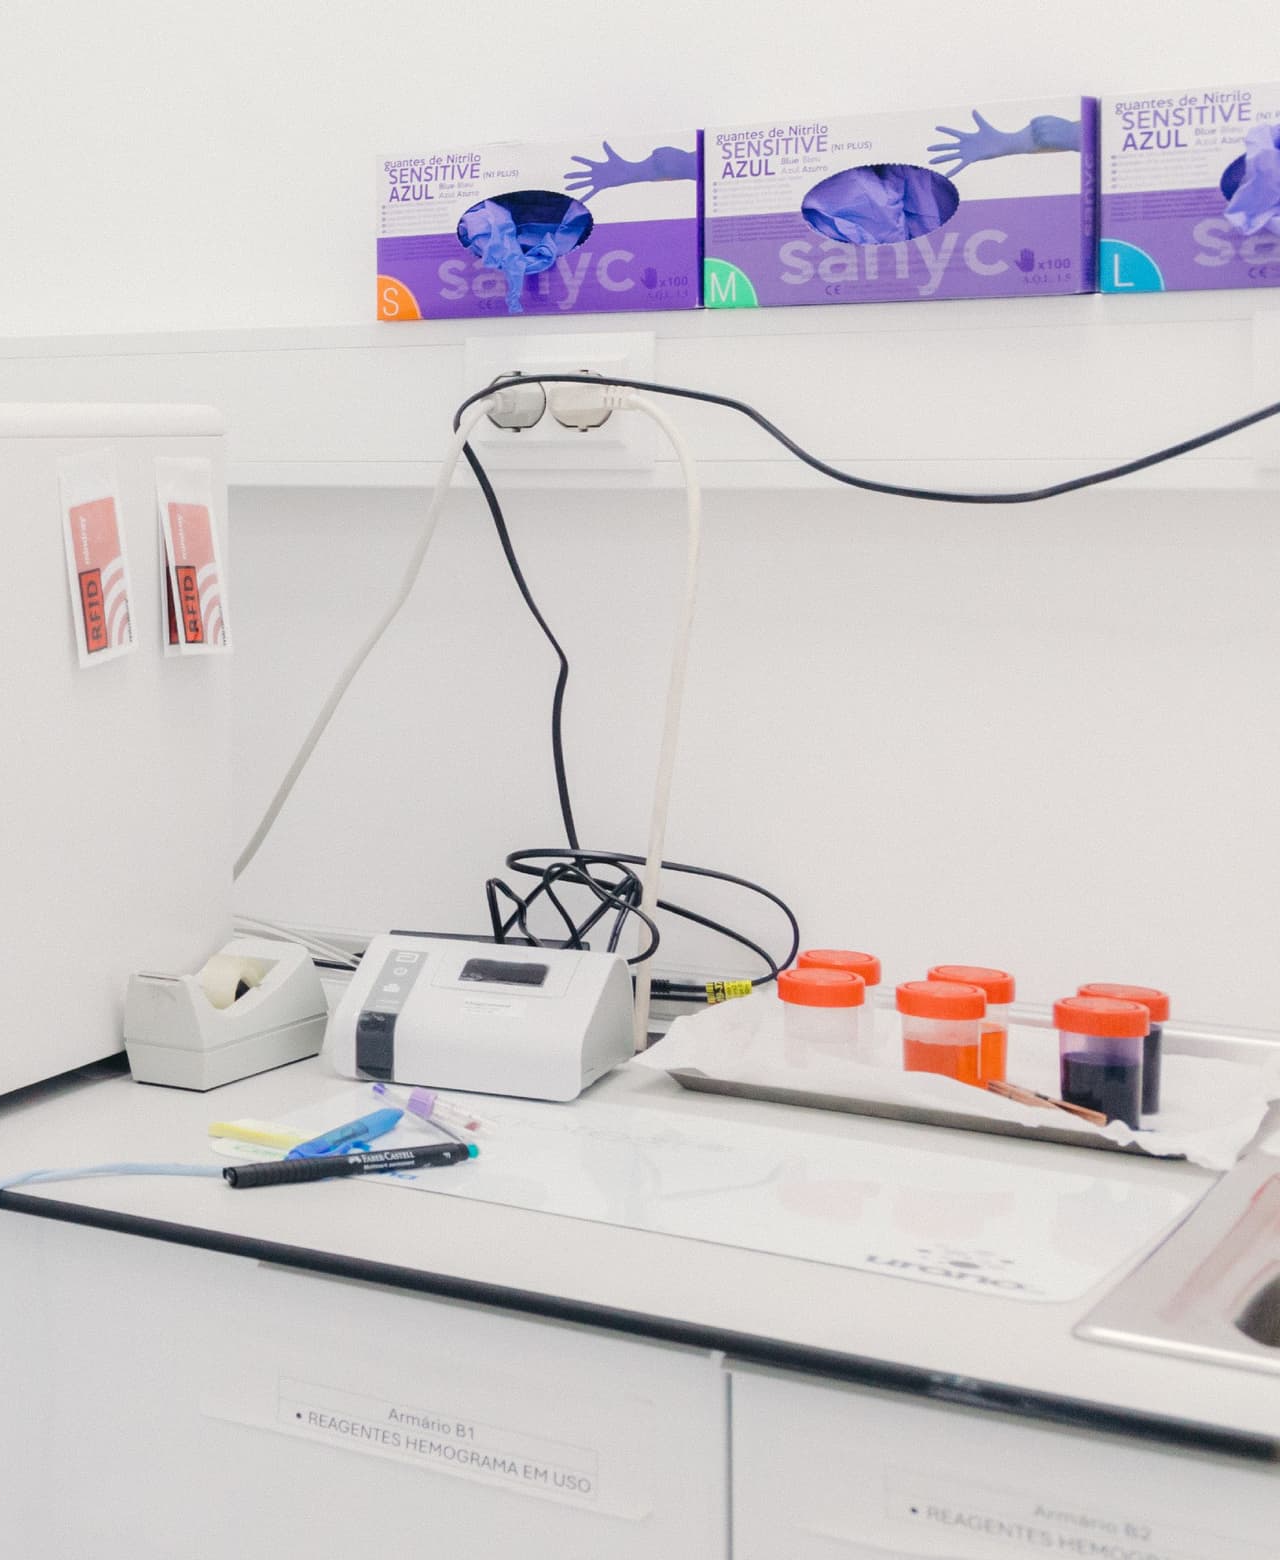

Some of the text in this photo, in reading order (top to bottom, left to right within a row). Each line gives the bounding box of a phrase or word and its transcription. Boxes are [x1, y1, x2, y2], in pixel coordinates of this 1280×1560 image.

[1115, 90, 1252, 115] guantes de Nitrilo
[1122, 102, 1252, 131] SENSITIVE
[716, 123, 829, 145] guantes de Nitrilo
[722, 135, 828, 160] SENSITIVE
[1122, 129, 1188, 152] AZUL
[384, 152, 482, 172] guantes de Nitrilo
[389, 162, 481, 185] SENSITIVE
[722, 159, 776, 179] AZUL
[389, 184, 434, 203] AZUL
[779, 229, 1009, 296] sanyc
[1114, 253, 1135, 287] L
[382, 287, 400, 317] S
[710, 272, 737, 303] M
[86, 580, 103, 641] RFID
[183, 575, 200, 633] RFID
[388, 1407, 476, 1441] Armário B1
[307, 1410, 592, 1495] REAGENTES HEMOGRAMA EM USO
[925, 1504, 1053, 1548] REAGENTES
